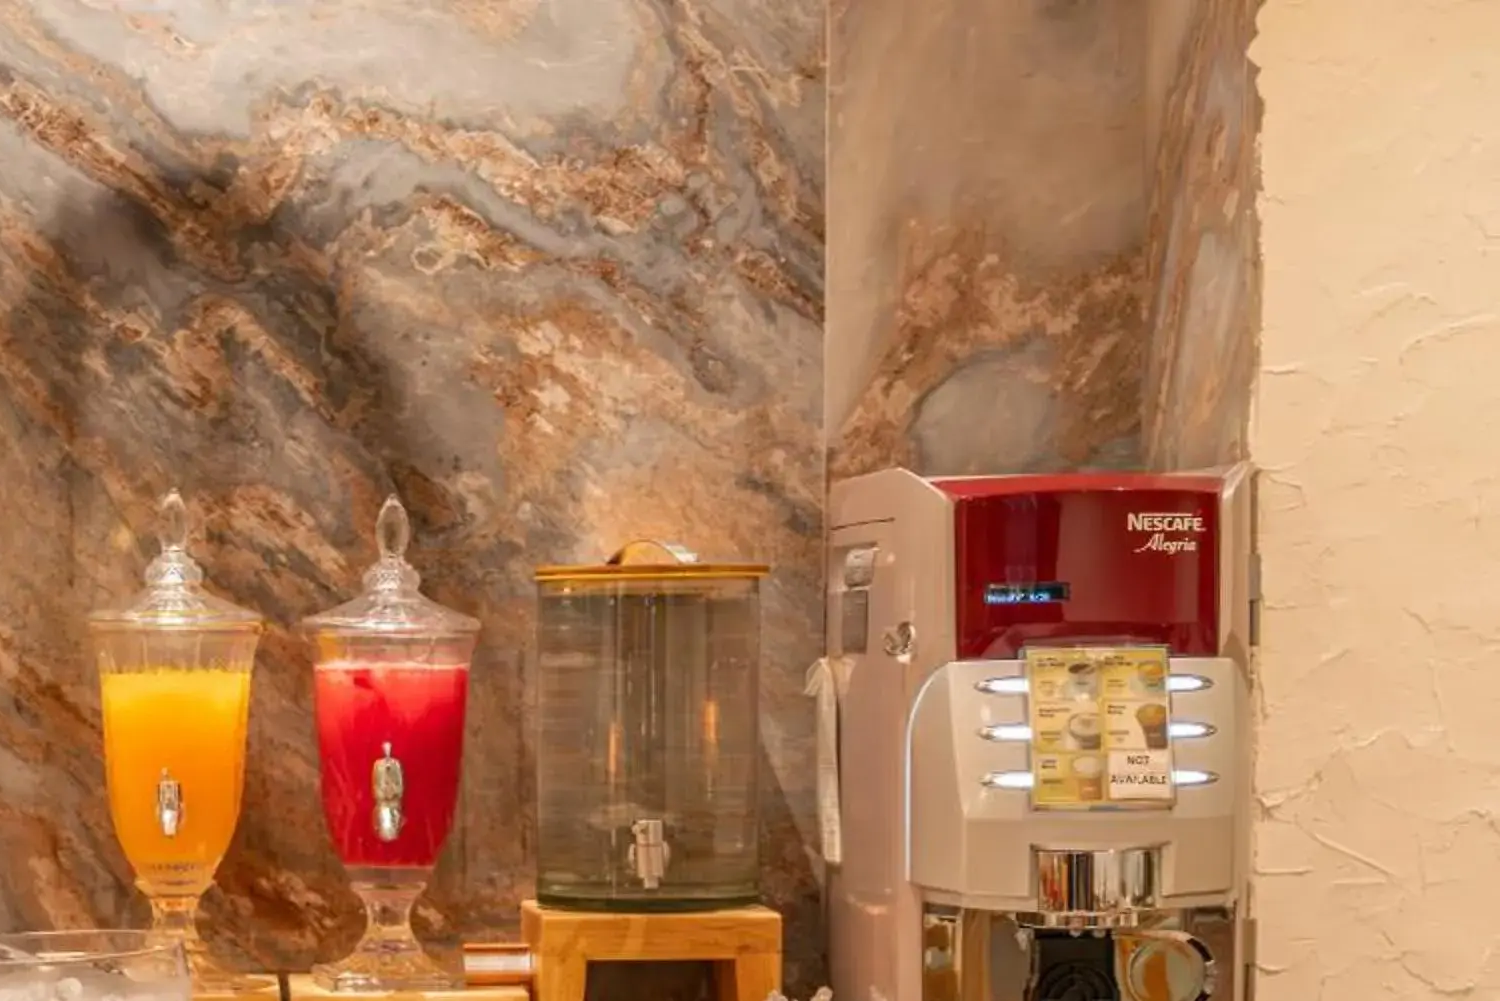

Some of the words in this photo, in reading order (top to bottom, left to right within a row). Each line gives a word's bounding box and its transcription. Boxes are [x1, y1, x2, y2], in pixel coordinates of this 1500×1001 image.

[1133, 533, 1196, 555] Alegria
[1127, 755, 1150, 765] NOT
[1111, 774, 1167, 785] AVAILABLE
